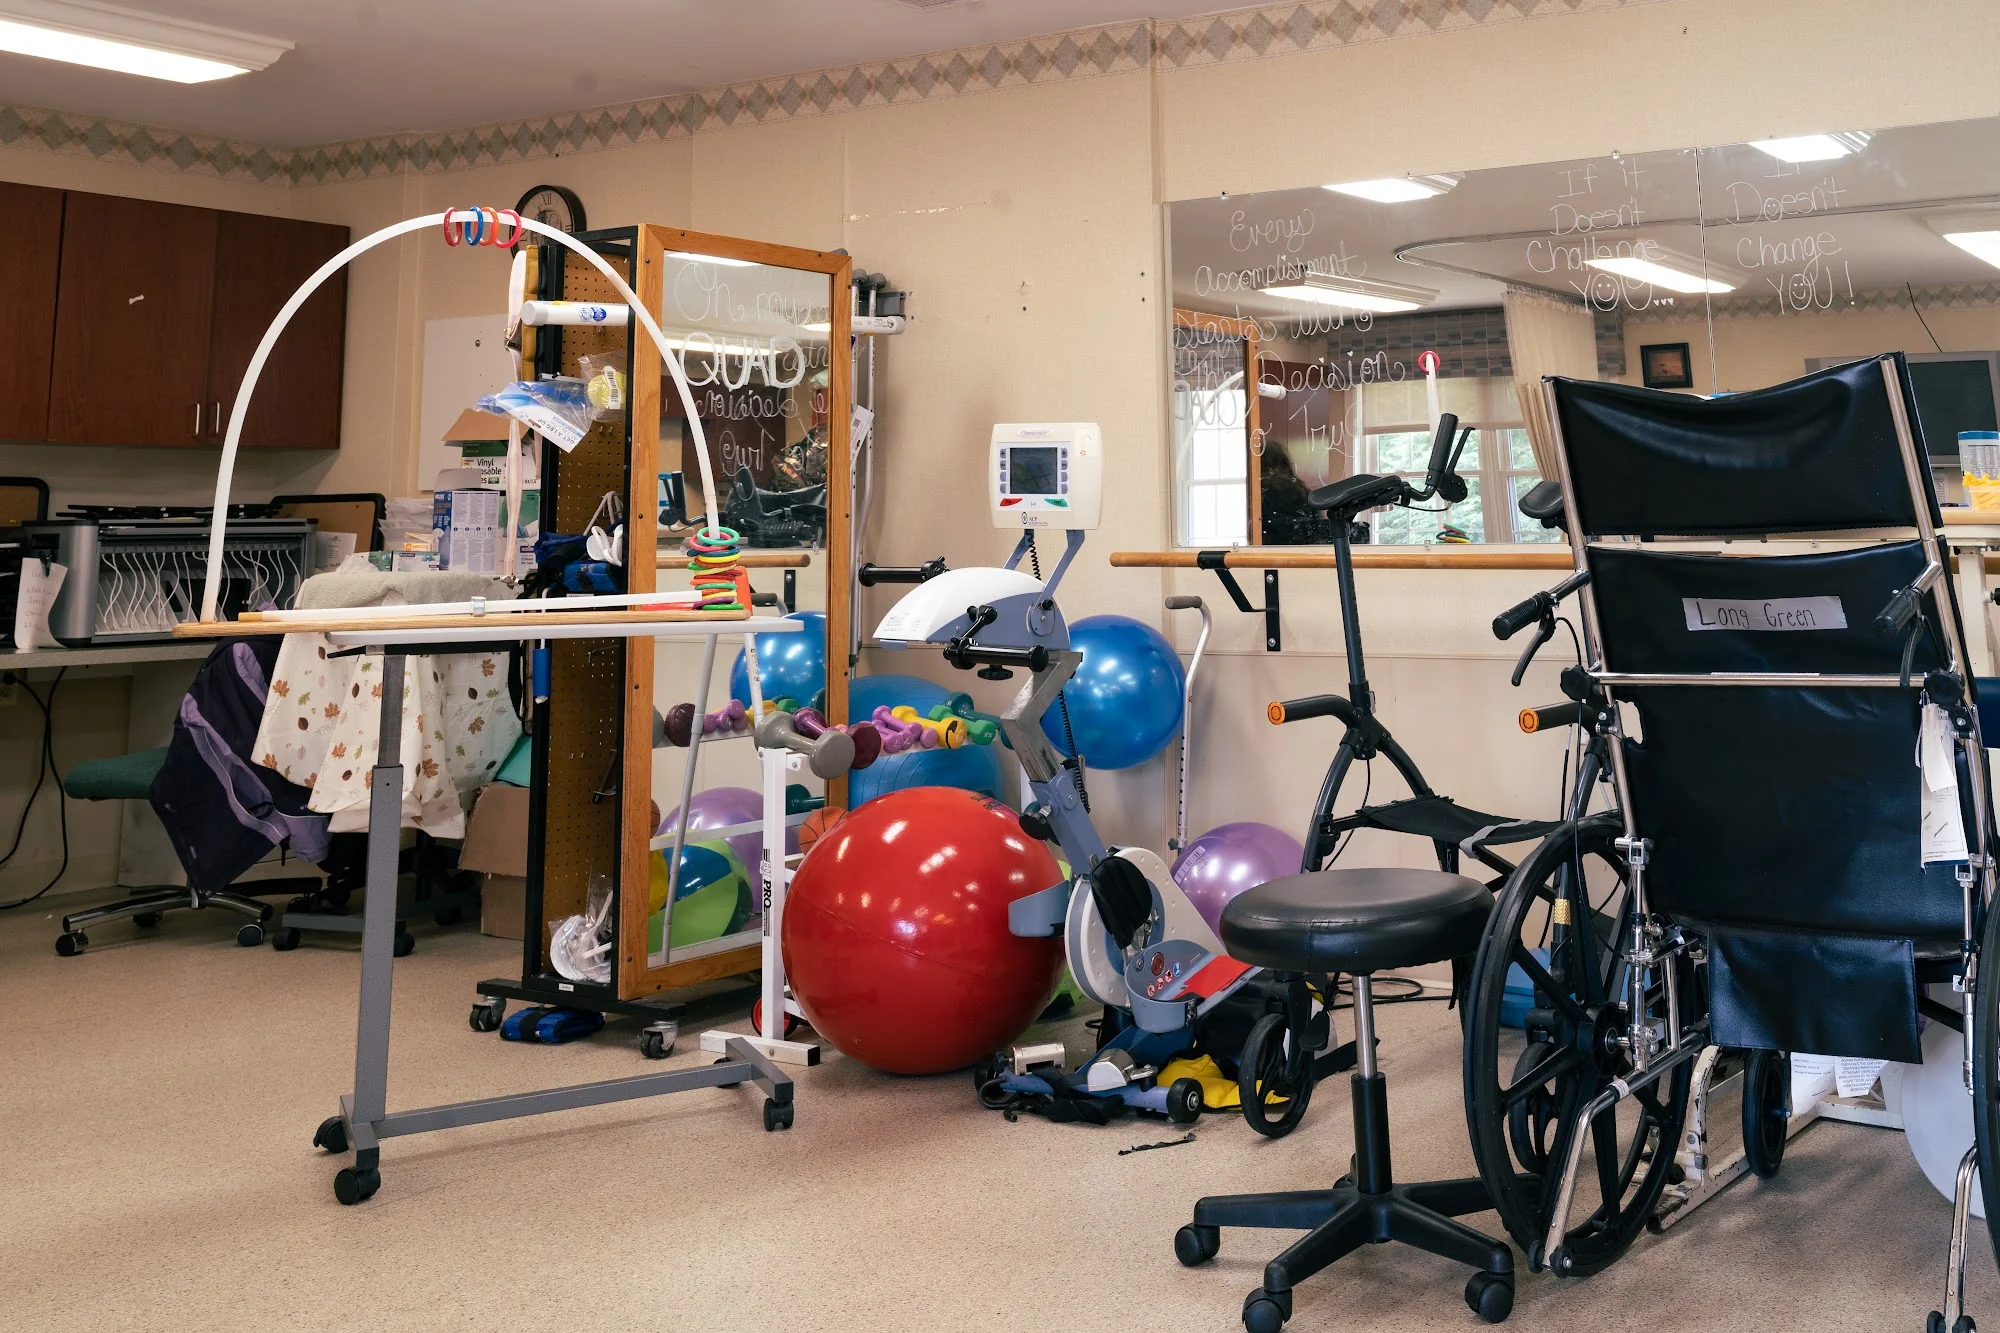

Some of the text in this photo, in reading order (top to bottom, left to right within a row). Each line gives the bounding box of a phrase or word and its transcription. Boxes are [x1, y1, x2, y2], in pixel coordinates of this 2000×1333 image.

[1557, 157, 1646, 198] If it
[1549, 196, 1646, 236] Doesn't
[1725, 176, 1848, 226] Doesn't
[1230, 208, 1315, 252] Every
[1195, 241, 1367, 297] Accomplishment
[1526, 236, 1668, 290] Challenge
[1736, 231, 1842, 288] Change
[674, 262, 746, 322] Oh
[1172, 305, 1277, 348] Starts
[679, 331, 806, 390] QUAD
[1253, 350, 1407, 392] Decision
[477, 458, 494, 468] Vinyl
[1695, 601, 1816, 629] Long Green
